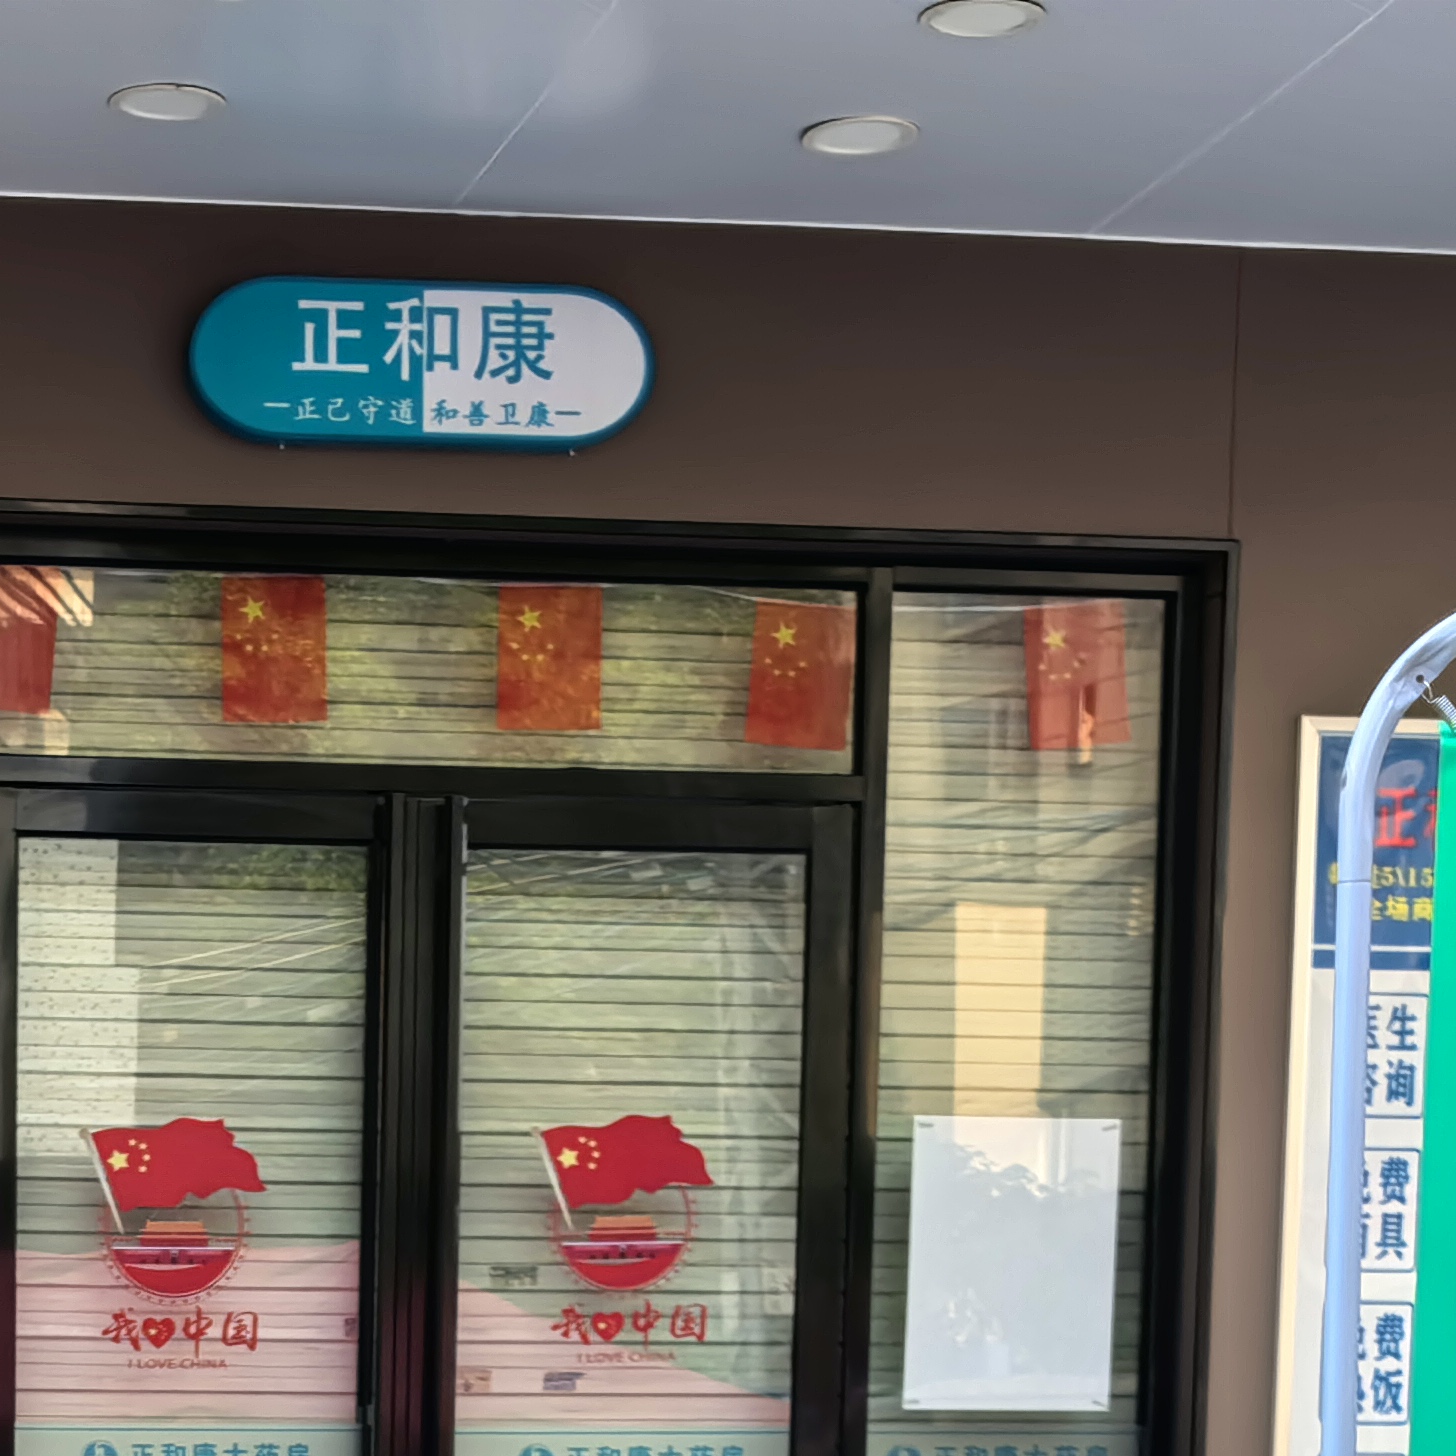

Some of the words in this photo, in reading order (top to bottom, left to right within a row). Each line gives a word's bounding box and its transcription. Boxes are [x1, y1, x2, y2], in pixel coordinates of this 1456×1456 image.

[292, 298, 555, 384] 正和康
[102, 1307, 141, 1351] 我
[183, 1305, 259, 1357] 中国
[551, 1305, 591, 1345] 我
[631, 1299, 708, 1349] 中国
